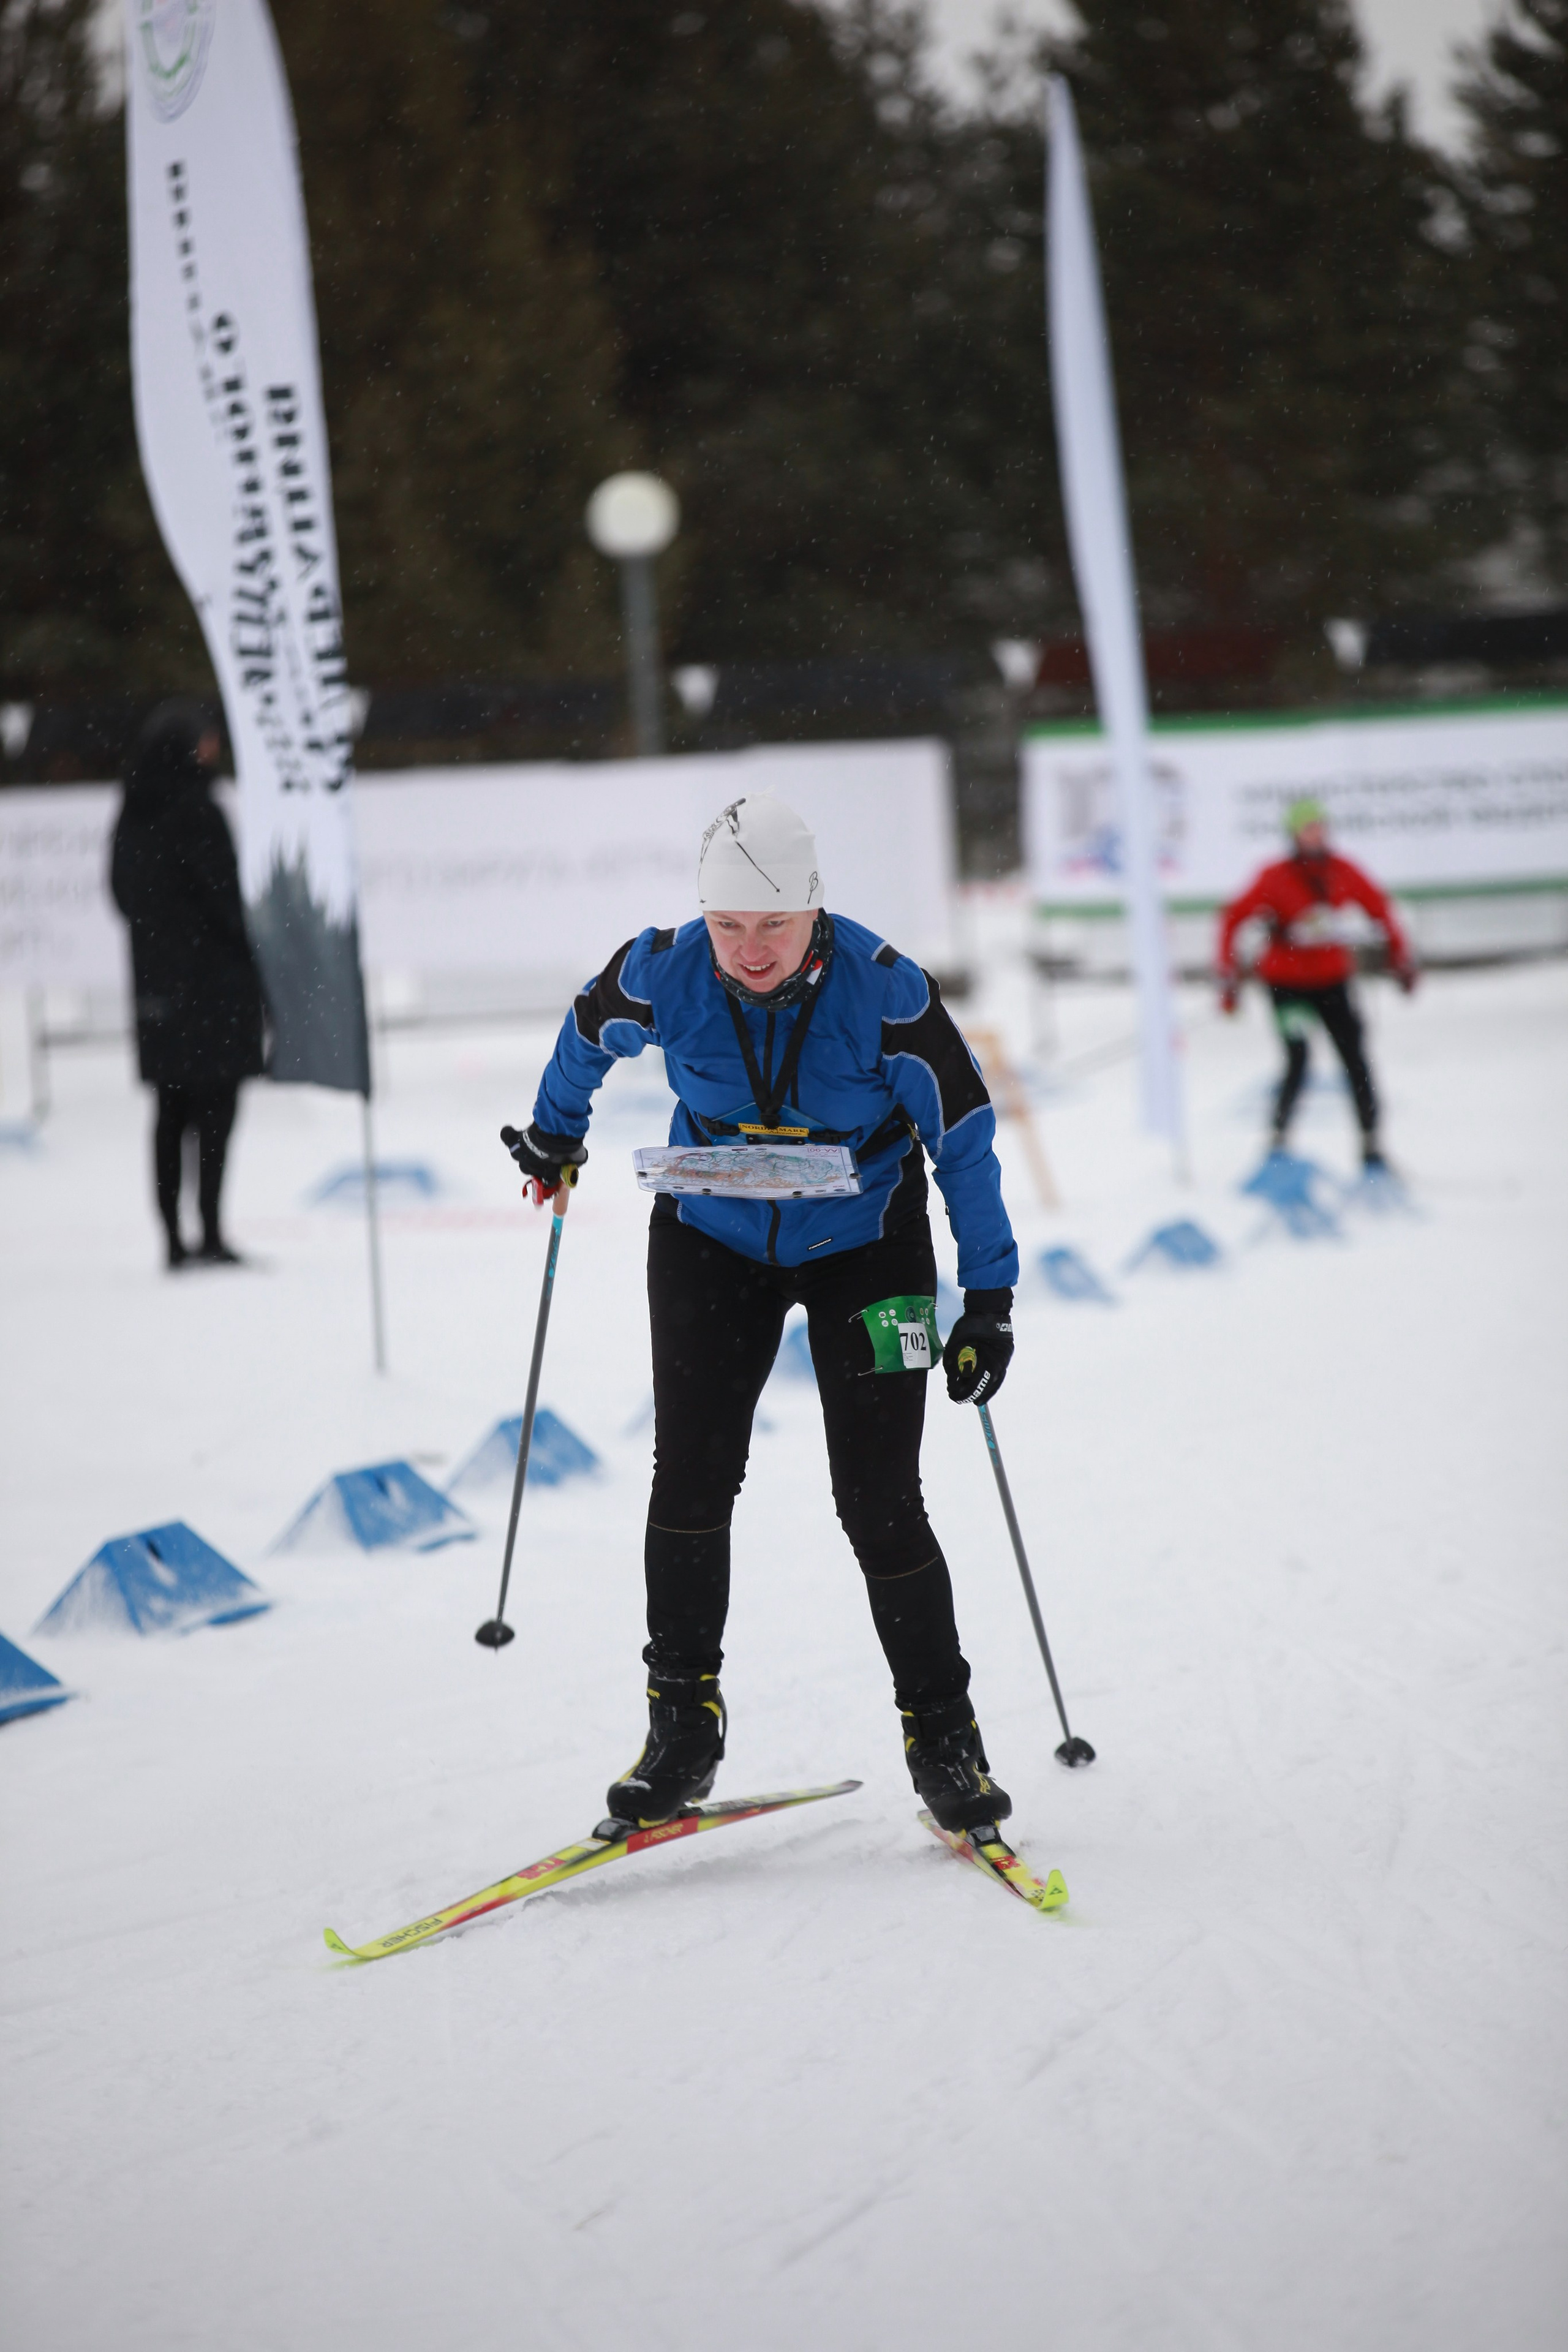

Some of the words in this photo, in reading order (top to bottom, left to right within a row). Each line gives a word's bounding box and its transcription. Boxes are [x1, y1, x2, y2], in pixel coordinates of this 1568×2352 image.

[741, 1125, 806, 1133] NORDMARK
[899, 1332, 927, 1351] 702
[956, 1370, 990, 1405] noname
[382, 1918, 443, 1948] FISCHER
